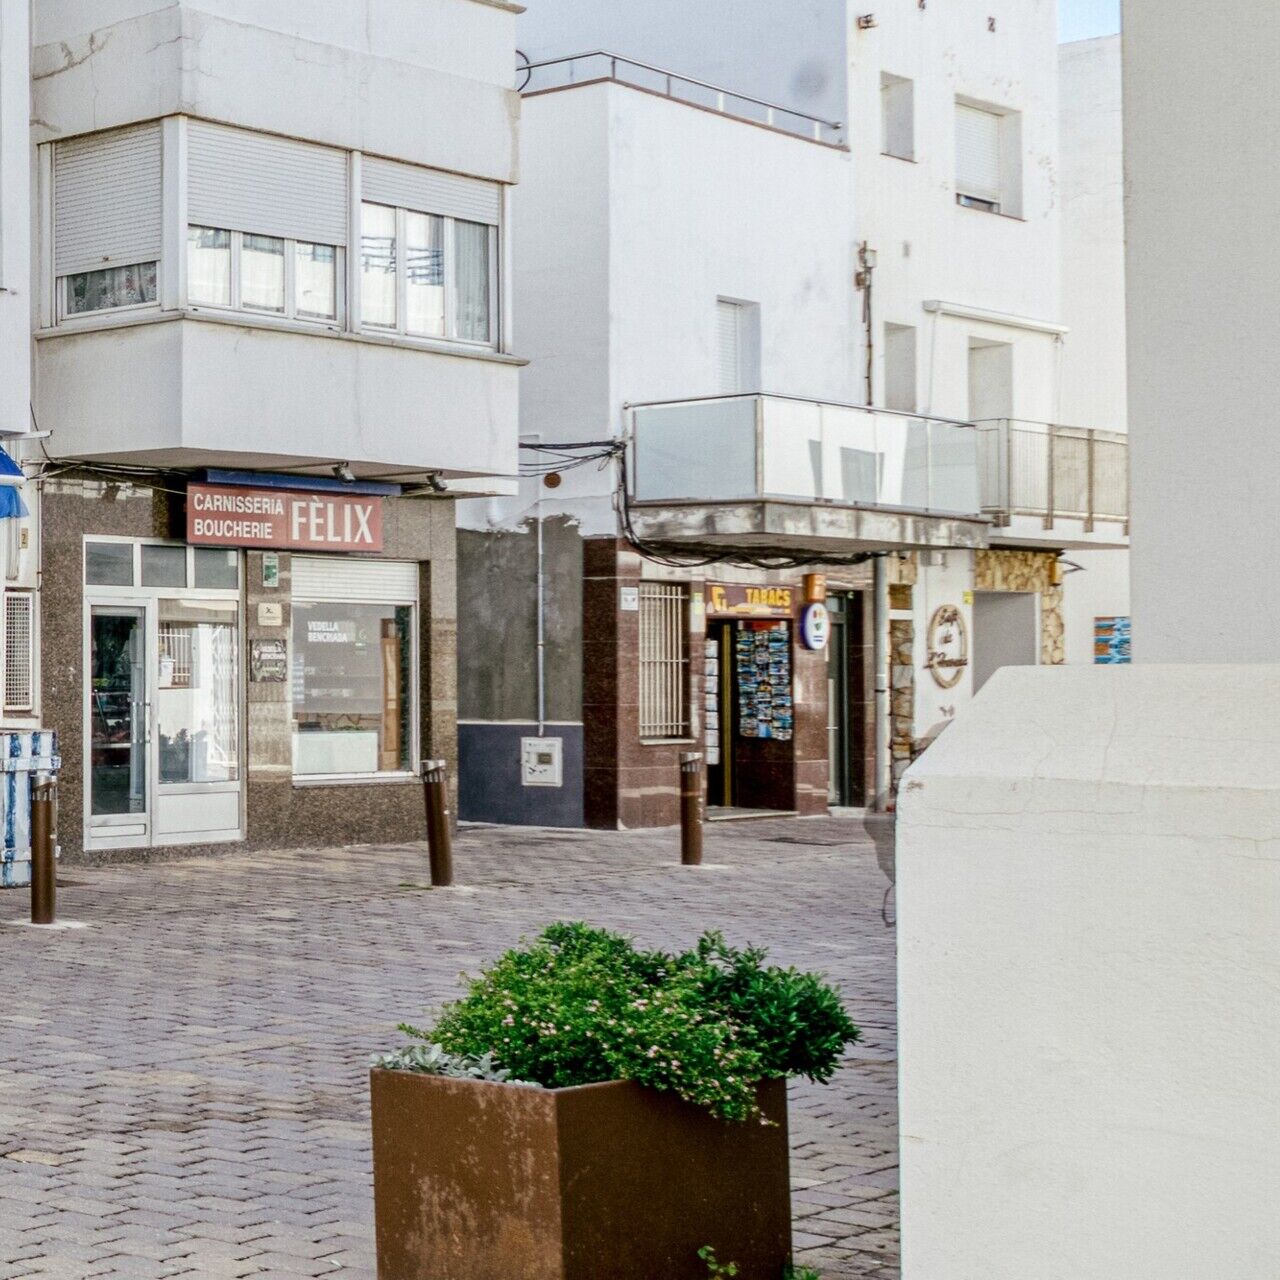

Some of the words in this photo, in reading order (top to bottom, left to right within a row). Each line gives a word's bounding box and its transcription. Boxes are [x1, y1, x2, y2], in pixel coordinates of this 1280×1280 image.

[194, 493, 284, 516] CARNISSERIA
[194, 518, 273, 539] BOUCHERIE
[291, 495, 373, 544] FÈLIX
[745, 588, 791, 607] TABACS
